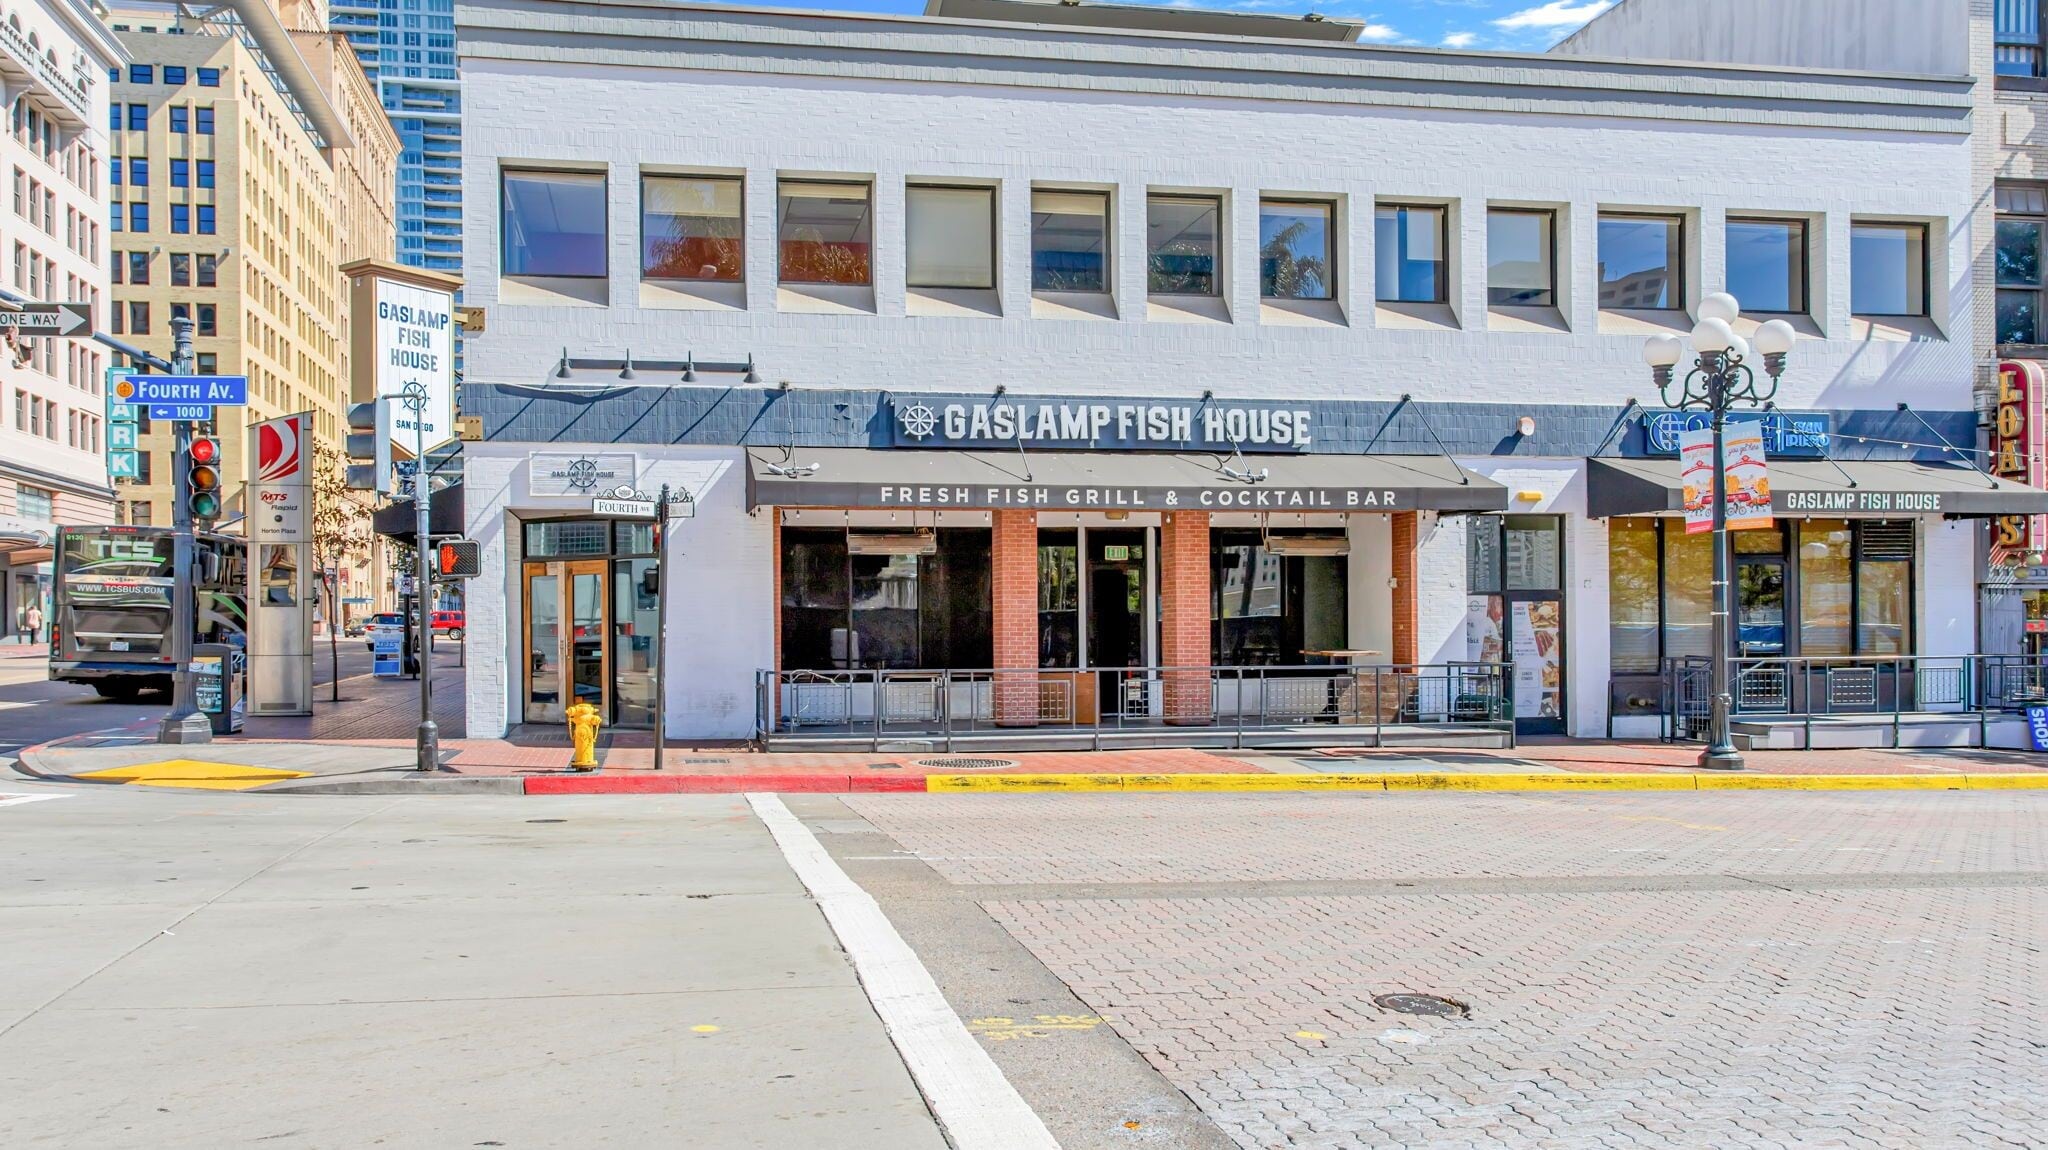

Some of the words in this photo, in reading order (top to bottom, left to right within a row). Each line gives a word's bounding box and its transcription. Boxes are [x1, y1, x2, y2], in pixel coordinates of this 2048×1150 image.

[0, 313, 27, 325] ONE
[32, 314, 59, 326] WAY
[379, 301, 449, 330] GASLAMP
[399, 326, 430, 349] FISH
[390, 347, 438, 373] HOUSE
[176, 406, 204, 418] 1000
[110, 371, 132, 474] ARK
[396, 419, 411, 430] SAN
[413, 421, 434, 432] DGO
[944, 404, 1111, 440] GASLAMP
[1117, 405, 1192, 441] FISH
[1204, 408, 1312, 445] HOUSE
[1793, 421, 1823, 434] SAN
[1998, 369, 2026, 546] LOAS
[261, 493, 288, 501] MTS
[881, 486, 969, 503] FRESH
[988, 488, 1048, 504] FISH
[1066, 489, 1144, 505] GRILL
[1165, 490, 1178, 506] &
[1200, 490, 1331, 506] COCKTAIL
[1347, 490, 1396, 506] BAR
[1787, 492, 1855, 509] GASLAMP
[1860, 493, 1890, 510] FISH
[1896, 494, 1941, 510] HOUSE
[598, 502, 638, 513] FOURTH
[90, 540, 154, 558] TCS
[76, 584, 165, 594] WWW.TCSBUS.COM
[2031, 708, 2048, 748] SHOP
